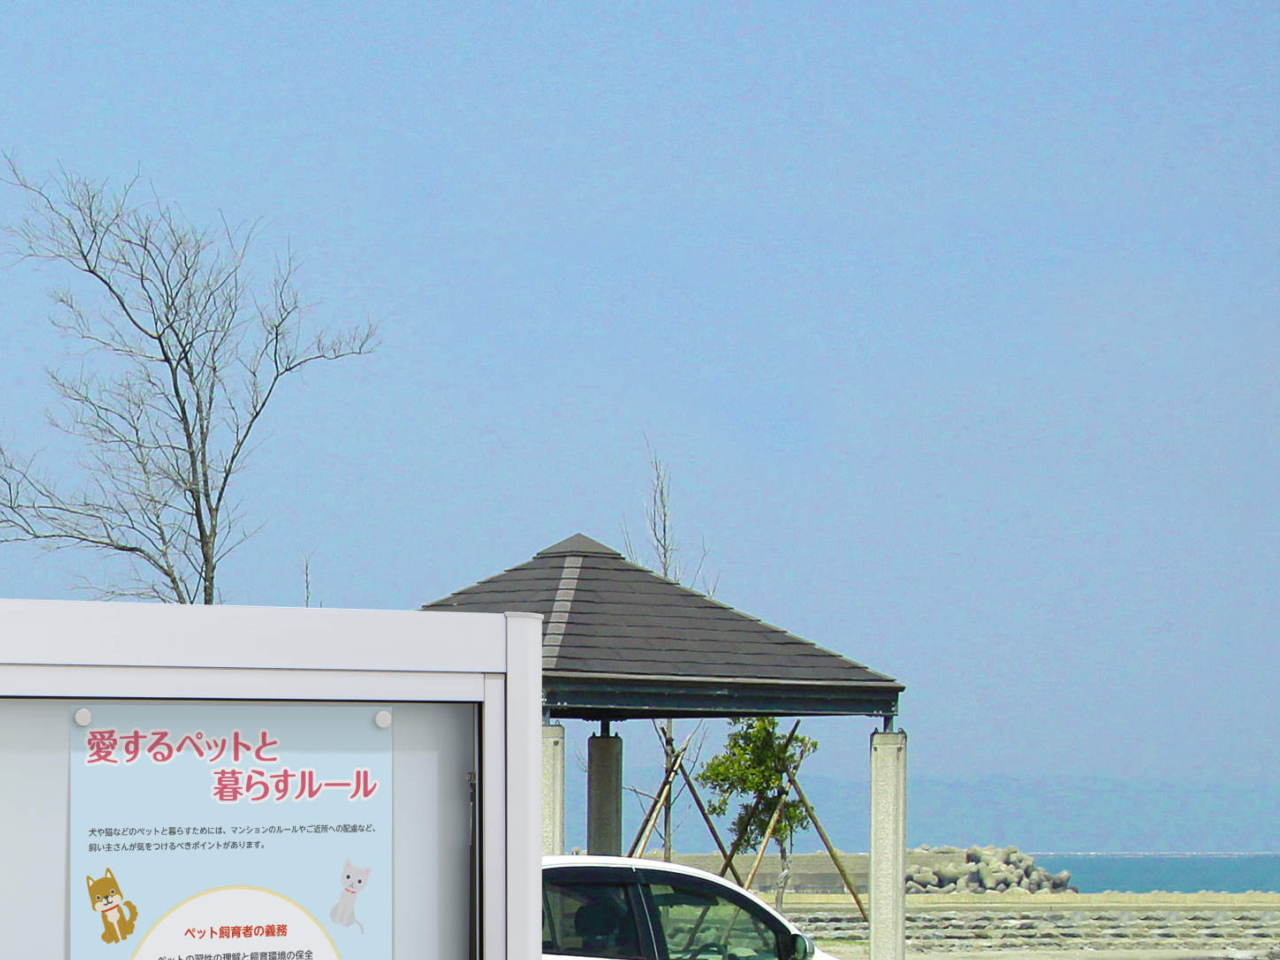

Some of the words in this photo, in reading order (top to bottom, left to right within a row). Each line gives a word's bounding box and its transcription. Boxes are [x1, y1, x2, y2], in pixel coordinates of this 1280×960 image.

[86, 729, 278, 763] 愛するペットと
[213, 768, 377, 801] 暮らすルール
[88, 841, 265, 852] 飼い主さんが気をつけるべきポイントがあります。
[184, 924, 288, 939] ペット飼育者の義務
